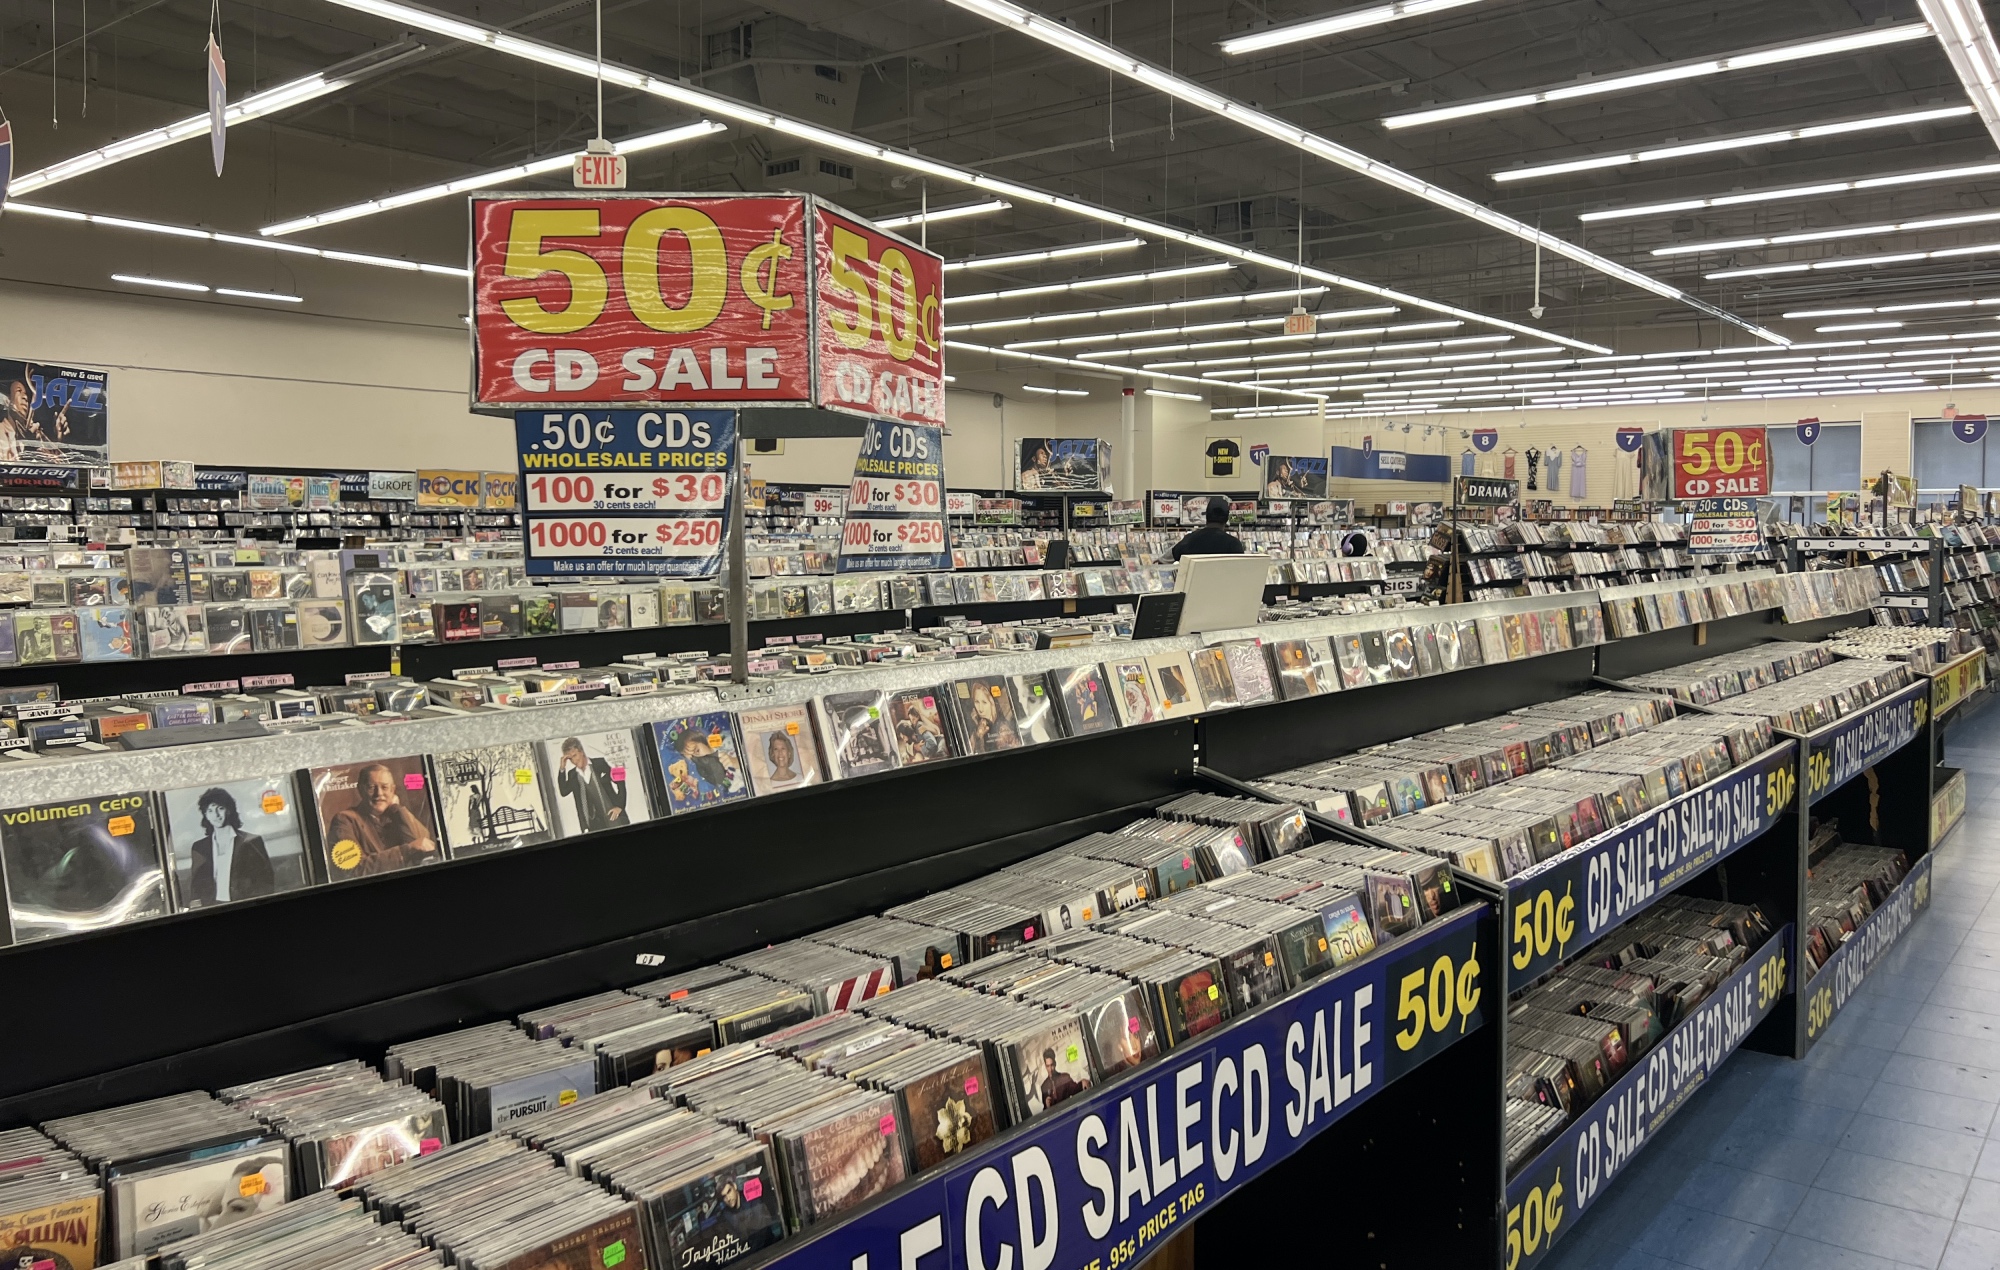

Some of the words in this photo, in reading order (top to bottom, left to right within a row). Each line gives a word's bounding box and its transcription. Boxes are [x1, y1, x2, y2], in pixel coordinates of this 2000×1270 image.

[582, 157, 618, 184] EXIT
[500, 207, 794, 334] 50¢
[829, 225, 939, 362] 50¢
[1290, 316, 1311, 333] EXIT
[79, 371, 85, 379] &
[87, 372, 104, 381] used
[512, 348, 598, 393] CD
[622, 347, 780, 393] SALE
[31, 374, 103, 410] JAZZ
[835, 362, 871, 404] CD
[879, 371, 937, 416] SALE
[637, 413, 712, 448] CDs
[1805, 427, 1812, 437] 6
[1964, 424, 1975, 435] 5
[890, 425, 928, 460] CDs
[1482, 435, 1489, 446] 8
[1626, 435, 1634, 445] 7
[522, 453, 652, 468] WHOLESALE
[659, 452, 727, 467] PRICES
[1048, 440, 1096, 462] JAZZ
[1254, 450, 1265, 460] 10
[1682, 431, 1762, 475] 50¢
[114, 464, 156, 477] LATIN
[898, 461, 938, 476] PRICES
[1289, 457, 1327, 476] JAZZ
[372, 480, 412, 491] EUROPE
[419, 476, 479, 495] ROCK
[486, 479, 514, 497] ROCK
[531, 476, 594, 503] 100
[604, 484, 643, 498] for
[851, 479, 870, 505] 100
[872, 488, 890, 501] for
[1469, 484, 1508, 498] DRAMA
[1685, 480, 1709, 495] CD
[1716, 478, 1759, 494] SALE
[593, 501, 604, 509] 30
[606, 501, 630, 509] cents
[633, 501, 656, 509] each!
[814, 499, 832, 512] 99¢
[1161, 503, 1174, 514] 99¢
[1723, 499, 1748, 511] CDs
[531, 521, 606, 547] 1000
[612, 529, 647, 544] for
[656, 520, 721, 546] $250
[844, 522, 871, 545] 1000
[873, 530, 892, 543] for
[898, 521, 943, 543] $250
[1693, 520, 1710, 529] 100
[1690, 536, 1712, 545] 1000
[1730, 534, 1757, 543] $250
[603, 546, 614, 555] 25
[615, 546, 639, 555] cents
[641, 546, 662, 555] each!
[553, 561, 574, 572] Make
[576, 562, 585, 571] us
[586, 562, 596, 571] an
[597, 561, 614, 571] offer
[615, 561, 626, 571] for
[627, 561, 646, 571] much
[647, 561, 667, 574] larger
[27, 709, 49, 718] GRANT
[50, 707, 71, 716] GREEN
[742, 713, 773, 724] DINAH
[775, 709, 805, 720] SHORE
[3, 803, 91, 826] volumen
[99, 796, 143, 812] cero
[1512, 879, 1575, 971] 50¢
[1587, 852, 1612, 934] CD
[1616, 827, 1655, 916] SALE
[1657, 808, 1678, 870] CD
[1681, 788, 1713, 858] SALE
[1714, 789, 1730, 854] CD
[1733, 774, 1760, 844] SALE
[1766, 764, 1795, 816] 50¢
[1659, 870, 1676, 889] IGNORE
[1676, 865, 1684, 879] THE
[1693, 853, 1705, 868] PRICE
[1330, 928, 1374, 958] TOTEM
[1807, 979, 1832, 1038] 50¢
[1052, 1020, 1078, 1036] HARRY
[1576, 1120, 1600, 1209] CD
[1605, 1074, 1646, 1179] SALE
[1648, 1046, 1669, 1114] CD
[1672, 1009, 1704, 1091] SALE
[1705, 1002, 1722, 1071] CD
[1724, 971, 1752, 1052] SALE
[1758, 947, 1785, 1010] 50¢
[510, 1101, 547, 1120] PURSUIT
[965, 1145, 1059, 1270] CD
[1077, 1061, 1205, 1241] SALE
[1211, 1042, 1269, 1182] CD
[1285, 983, 1373, 1138] SALE
[1395, 942, 1481, 1051] 50¢
[144, 1201, 178, 1222] Gloria
[1139, 1204, 1177, 1248] PRICE
[1179, 1183, 1205, 1214] TAG
[14, 1216, 89, 1247] SULLIVAN
[682, 1234, 739, 1268] Taylor
[713, 1242, 751, 1265] Hicks
